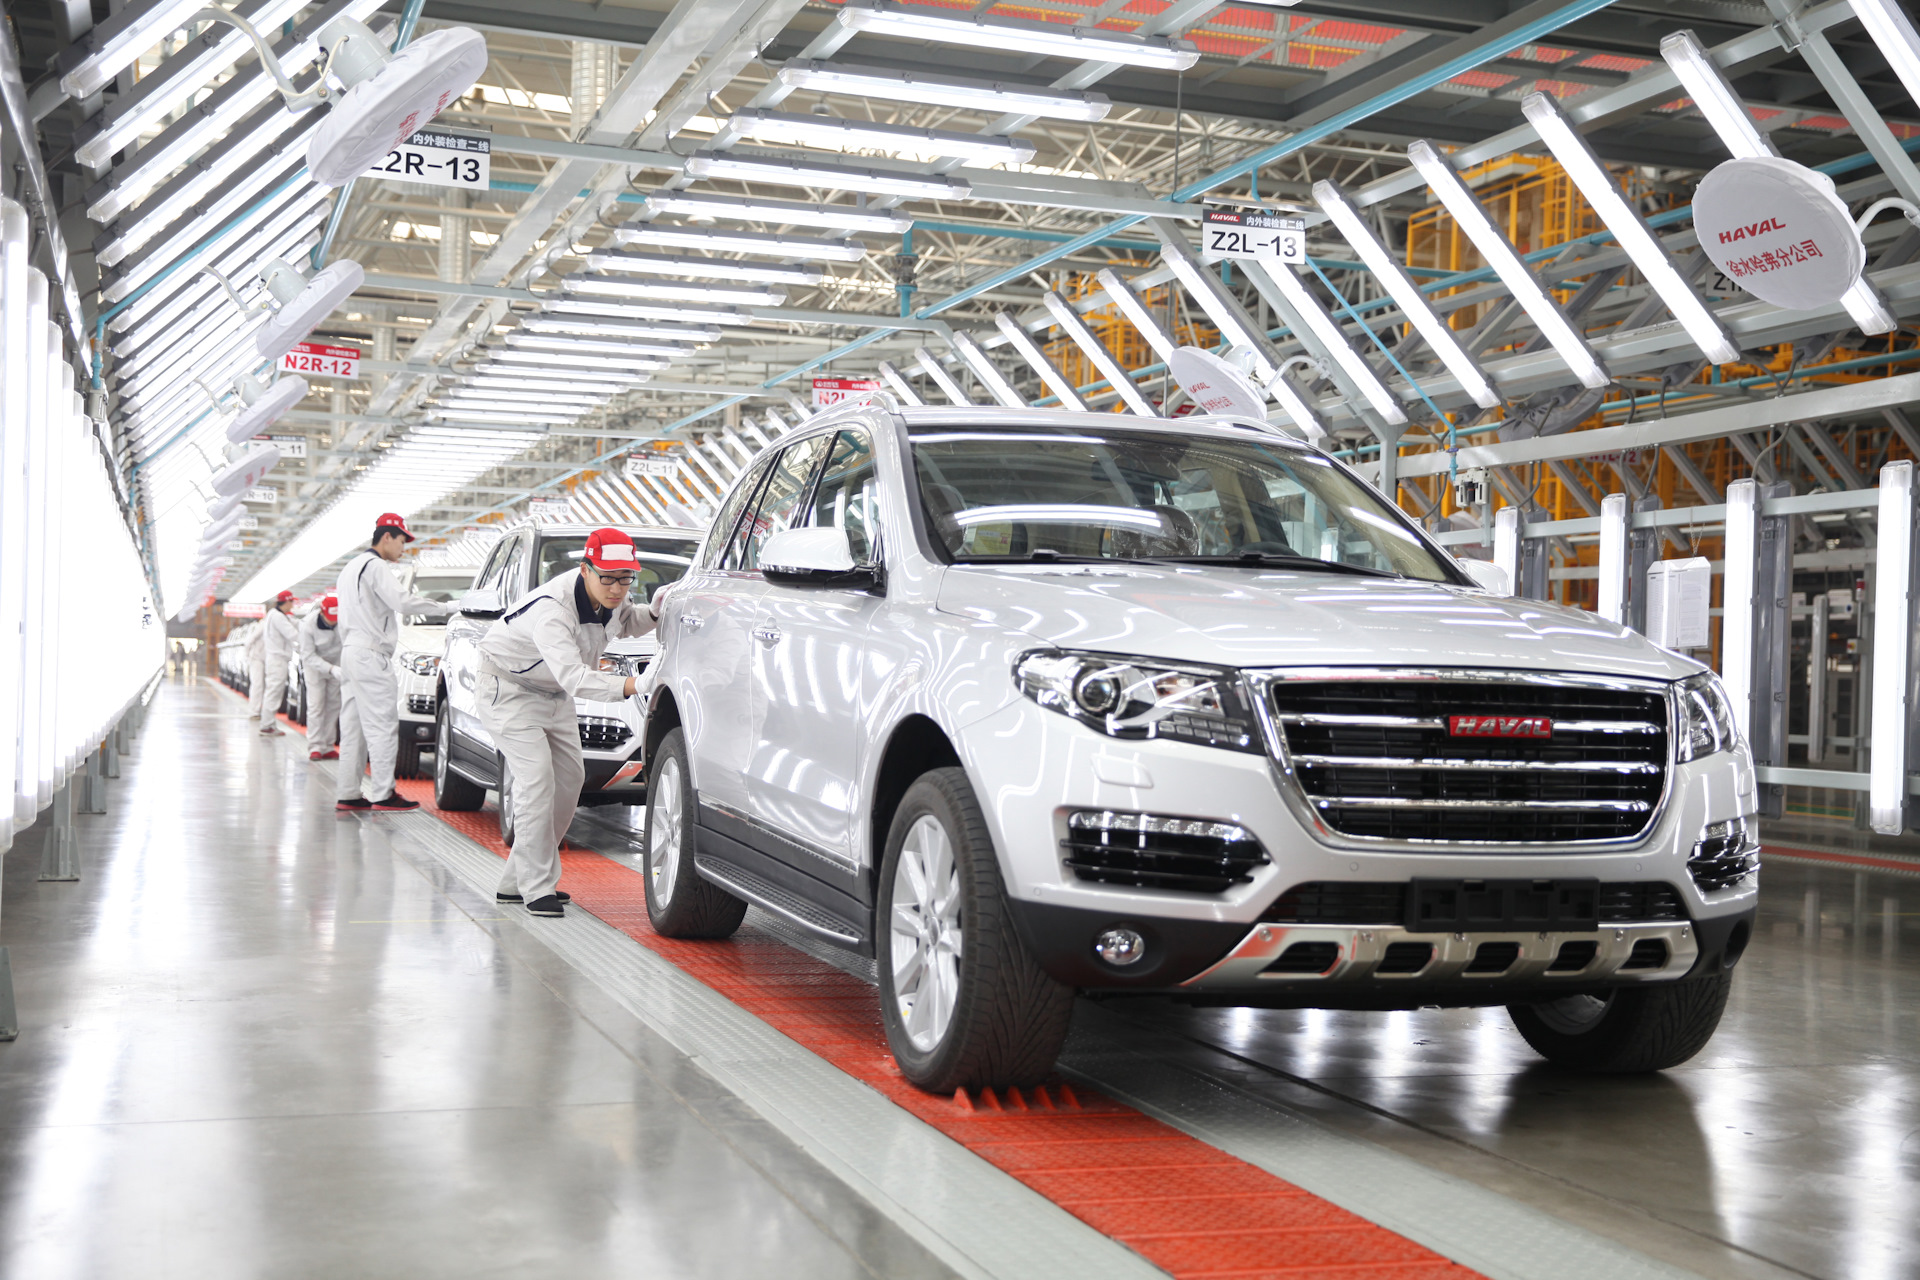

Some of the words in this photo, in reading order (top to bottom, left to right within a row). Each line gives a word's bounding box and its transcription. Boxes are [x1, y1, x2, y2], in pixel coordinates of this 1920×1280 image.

[413, 134, 489, 152] 内外装检查二线
[370, 150, 480, 182] 2R-13
[1210, 213, 1239, 222] HAVAL
[1246, 216, 1304, 231] 内外装检查二线
[1718, 217, 1786, 244] HAVAL
[1210, 230, 1297, 257] Z2L-13
[1726, 239, 1823, 277] 徐水哈弗分公司
[284, 354, 352, 376] N2R-12
[631, 461, 673, 474] Z2L-11
[1455, 718, 1549, 736] HAVAL
